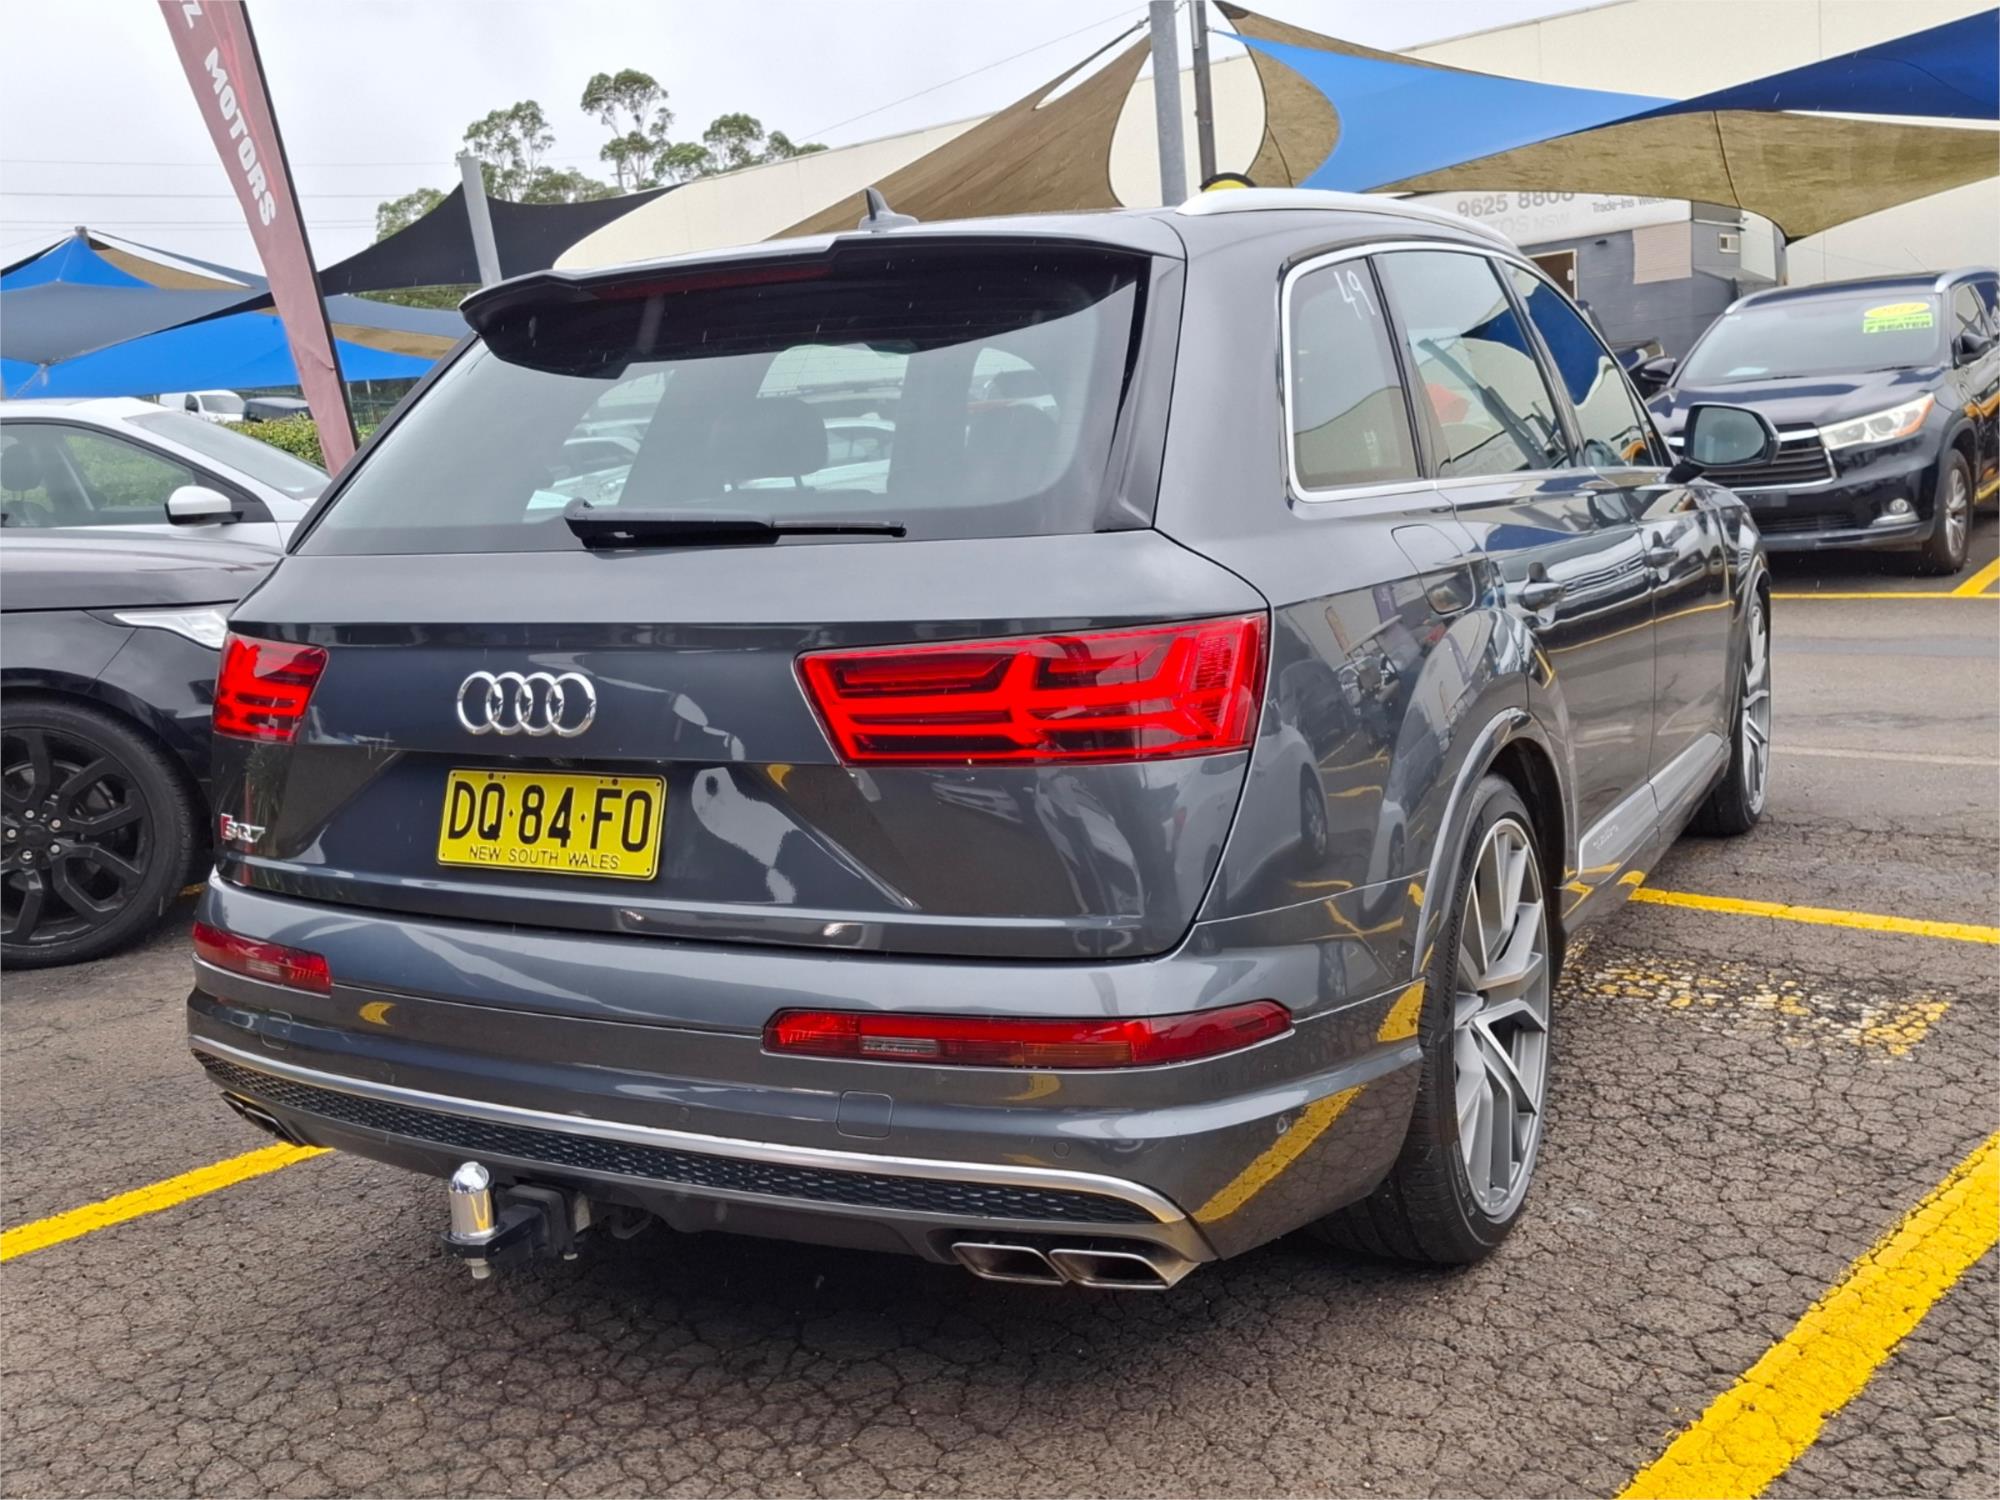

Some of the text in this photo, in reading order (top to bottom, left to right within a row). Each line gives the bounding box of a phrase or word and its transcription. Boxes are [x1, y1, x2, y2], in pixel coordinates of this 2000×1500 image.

[204, 47, 276, 226] MOTORS
[1456, 193, 1509, 217] 9625
[1333, 269, 1376, 320] 49
[468, 845, 620, 870] NEW SOUTH WALES
